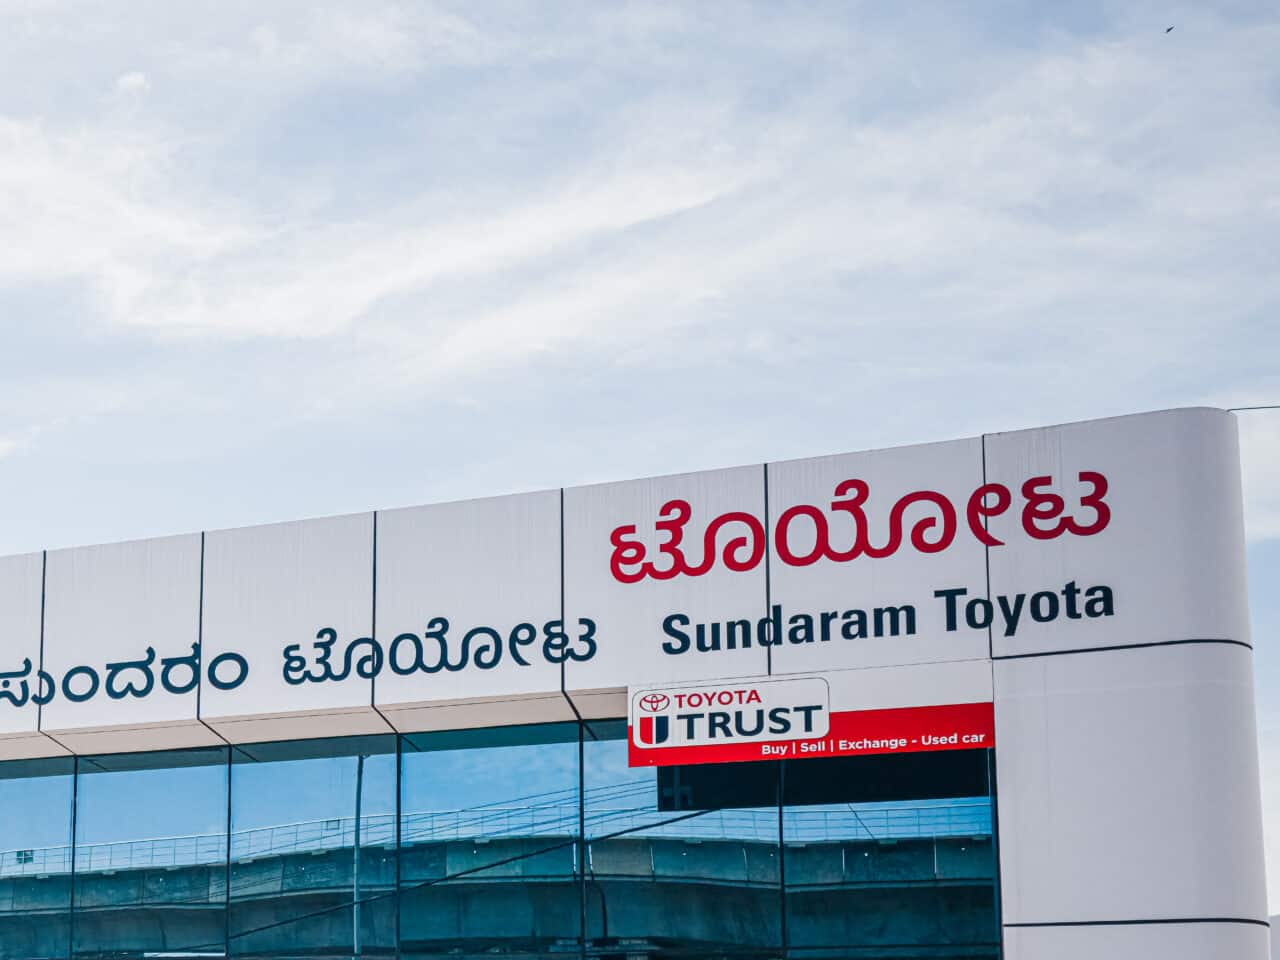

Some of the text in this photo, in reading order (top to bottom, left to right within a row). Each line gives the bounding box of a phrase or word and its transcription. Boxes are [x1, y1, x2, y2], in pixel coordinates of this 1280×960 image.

[662, 580, 1115, 656] Sundaram Toyota
[674, 689, 762, 709] TOYOTA
[677, 705, 823, 740] TRUST
[761, 744, 787, 756] Buy
[800, 740, 826, 753] Sell
[839, 736, 908, 752] Exchange
[921, 733, 957, 747] Used
[962, 731, 986, 744] car
